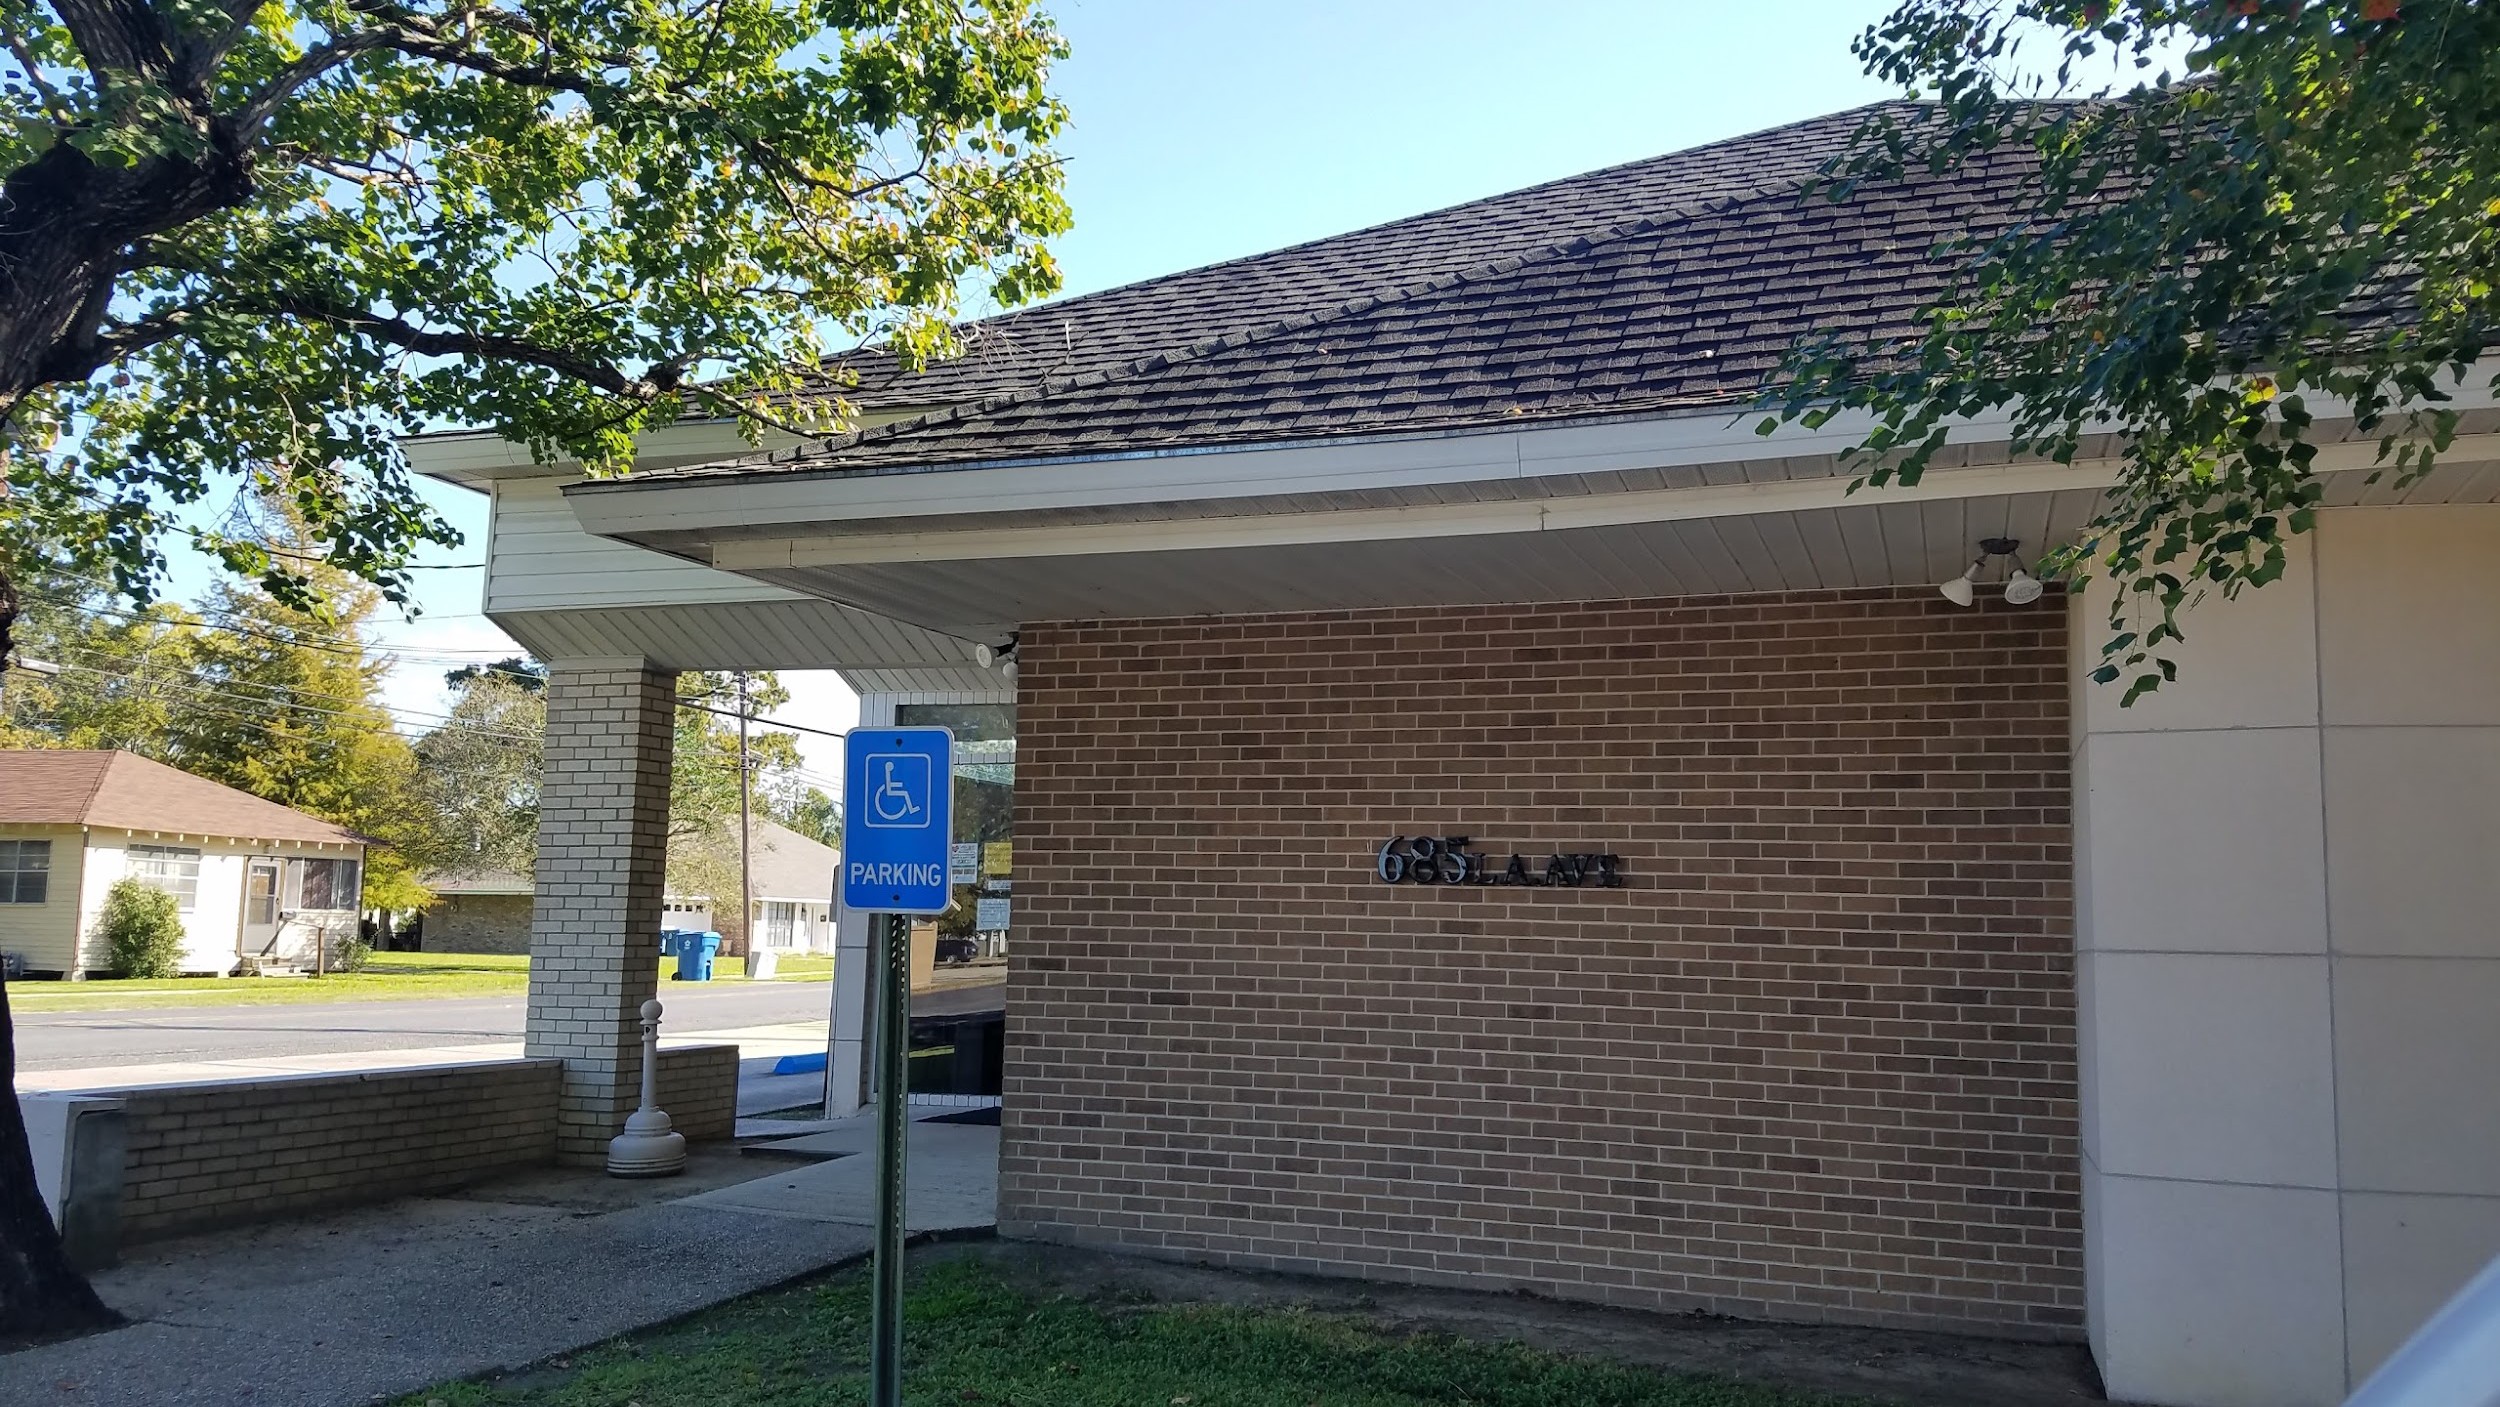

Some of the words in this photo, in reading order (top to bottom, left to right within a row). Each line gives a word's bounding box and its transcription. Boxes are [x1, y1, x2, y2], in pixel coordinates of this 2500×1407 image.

[850, 862, 942, 887] PARKING
[1377, 836, 1470, 885] 685
[1544, 853, 1624, 888] AVE
